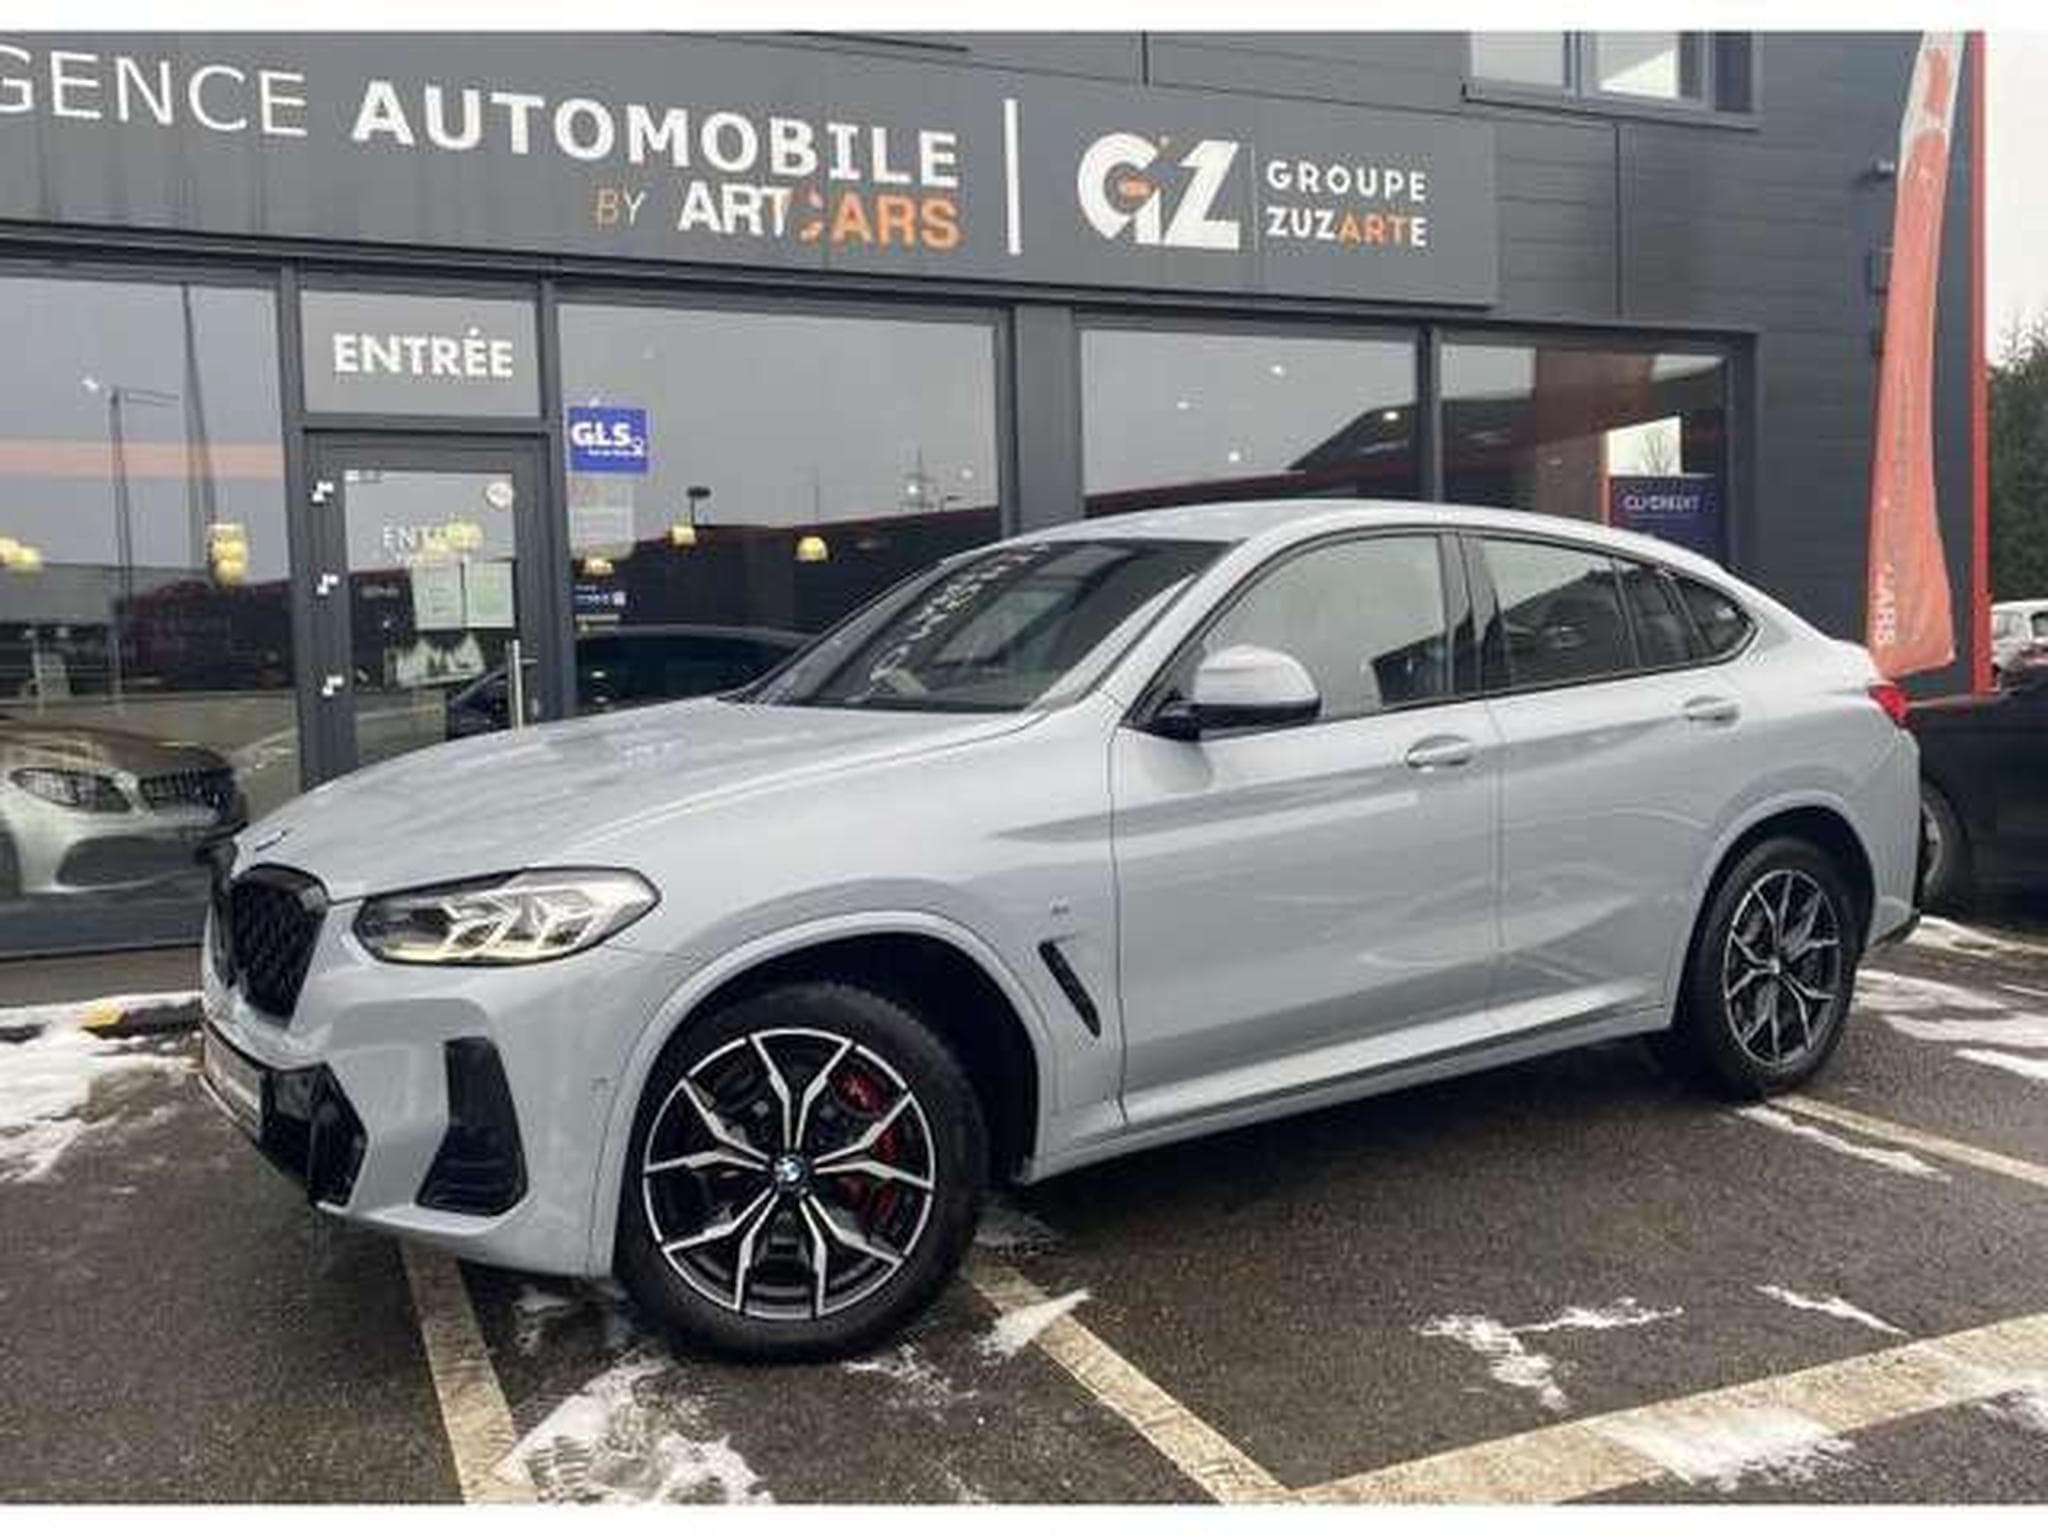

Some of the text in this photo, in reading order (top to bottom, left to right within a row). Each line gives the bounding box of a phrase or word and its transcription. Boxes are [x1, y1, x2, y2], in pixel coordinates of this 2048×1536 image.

[351, 80, 959, 188] AUTOMOBILE
[1266, 160, 1428, 201] GROUPE
[594, 188, 646, 226] BY
[1266, 206, 1428, 247] ZUZARTE
[331, 327, 515, 379] ENTRÉE
[572, 420, 632, 447] GLS
